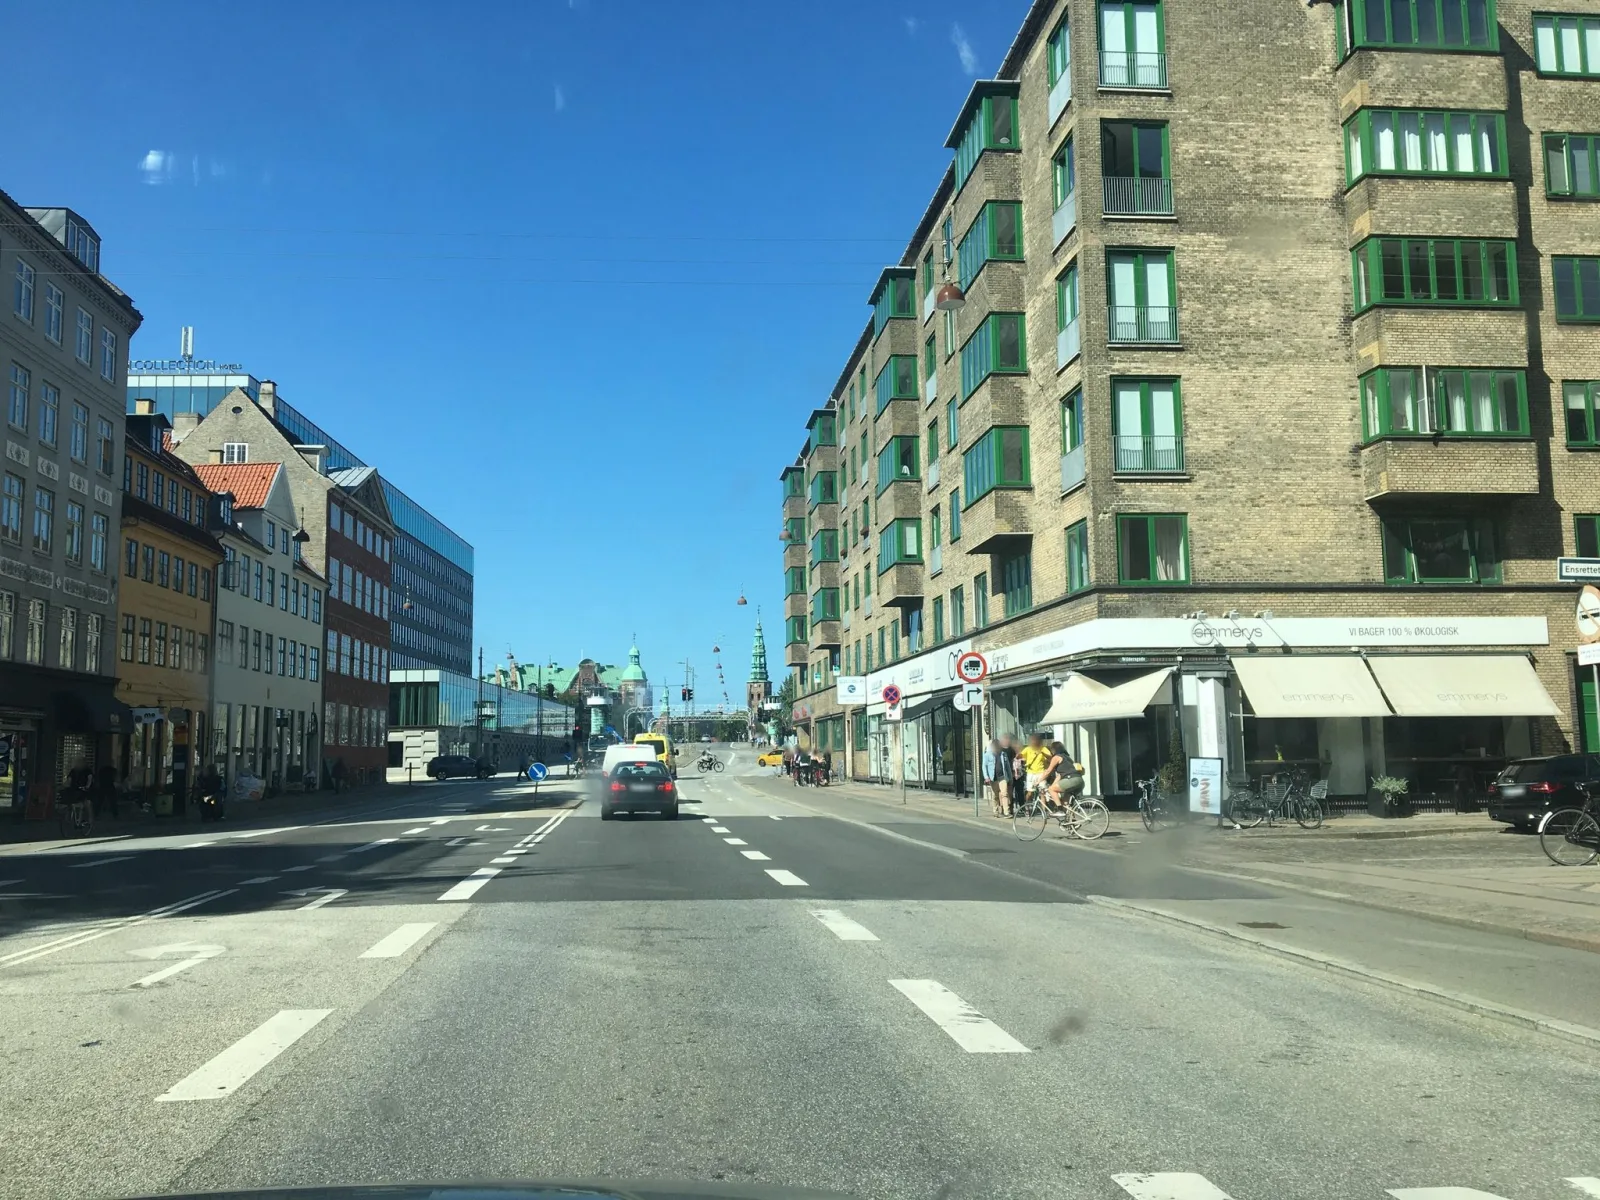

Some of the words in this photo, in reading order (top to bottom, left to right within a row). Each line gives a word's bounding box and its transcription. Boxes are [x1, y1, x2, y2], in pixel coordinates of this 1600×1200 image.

[134, 360, 216, 370] COLLECTION
[1193, 627, 1263, 641] emmerys
[1348, 627, 1357, 637] VI
[1358, 627, 1385, 637] BAGER
[1388, 627, 1402, 637] 100
[1404, 627, 1412, 636] %
[1414, 626, 1459, 636] ØKOLOGISK
[1282, 693, 1355, 703] emmerys
[1436, 693, 1508, 702] emmerys
